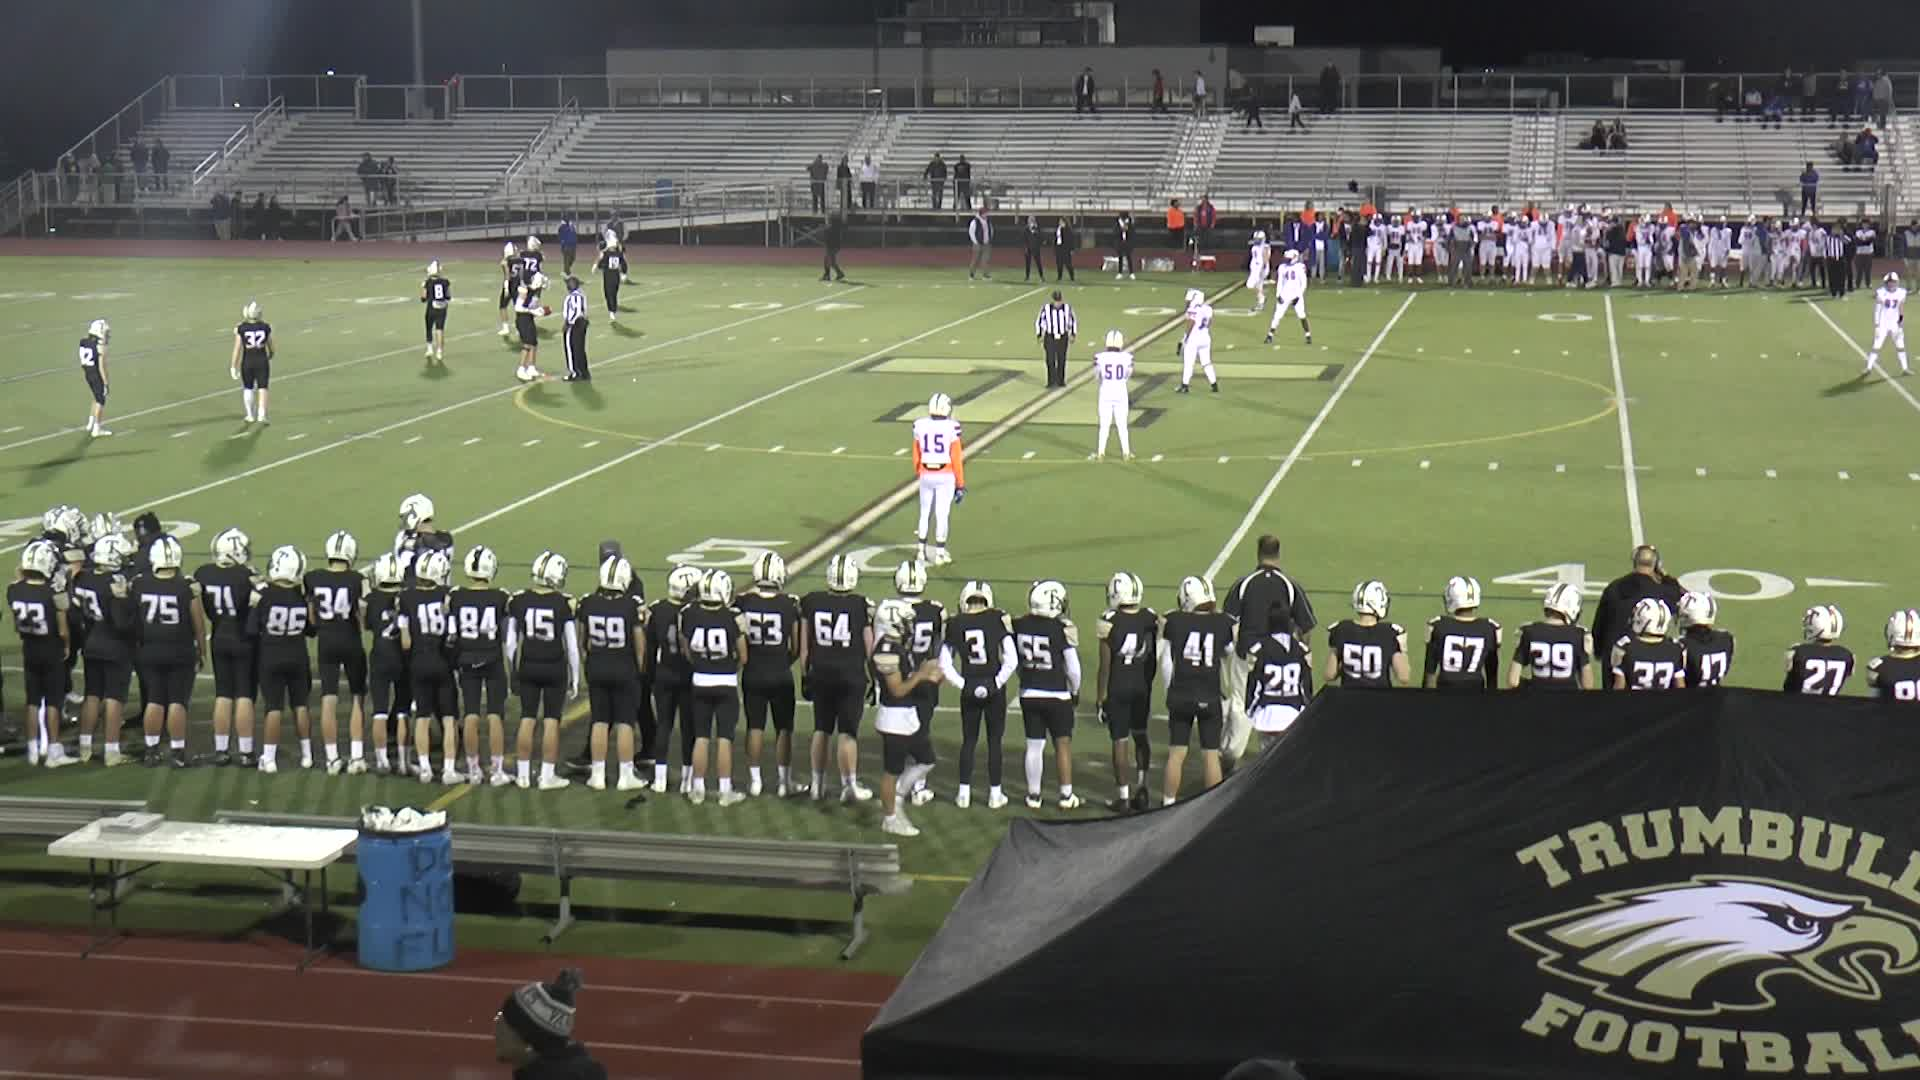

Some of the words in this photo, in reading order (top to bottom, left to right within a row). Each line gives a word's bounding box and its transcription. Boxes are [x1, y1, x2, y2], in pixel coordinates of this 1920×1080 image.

[434, 284, 445, 298] 8
[243, 330, 266, 349] 32
[1103, 363, 1125, 381] 50
[922, 434, 946, 455] 15
[140, 593, 180, 625] 75
[205, 585, 237, 616] 71
[313, 586, 351, 620] 34
[266, 605, 307, 636] 86
[459, 606, 498, 641] 84
[524, 607, 555, 641] 15
[587, 615, 626, 649] 59
[814, 611, 852, 648] 64
[689, 626, 729, 660] 49
[965, 629, 988, 665] 3
[1016, 633, 1053, 670] 55
[1119, 632, 1139, 665] 4
[1182, 631, 1215, 668] 41
[1442, 634, 1485, 674] 67
[1529, 641, 1574, 679] 39
[1342, 642, 1383, 679] 50
[1802, 659, 1846, 696] 27
[1263, 663, 1302, 699] 28
